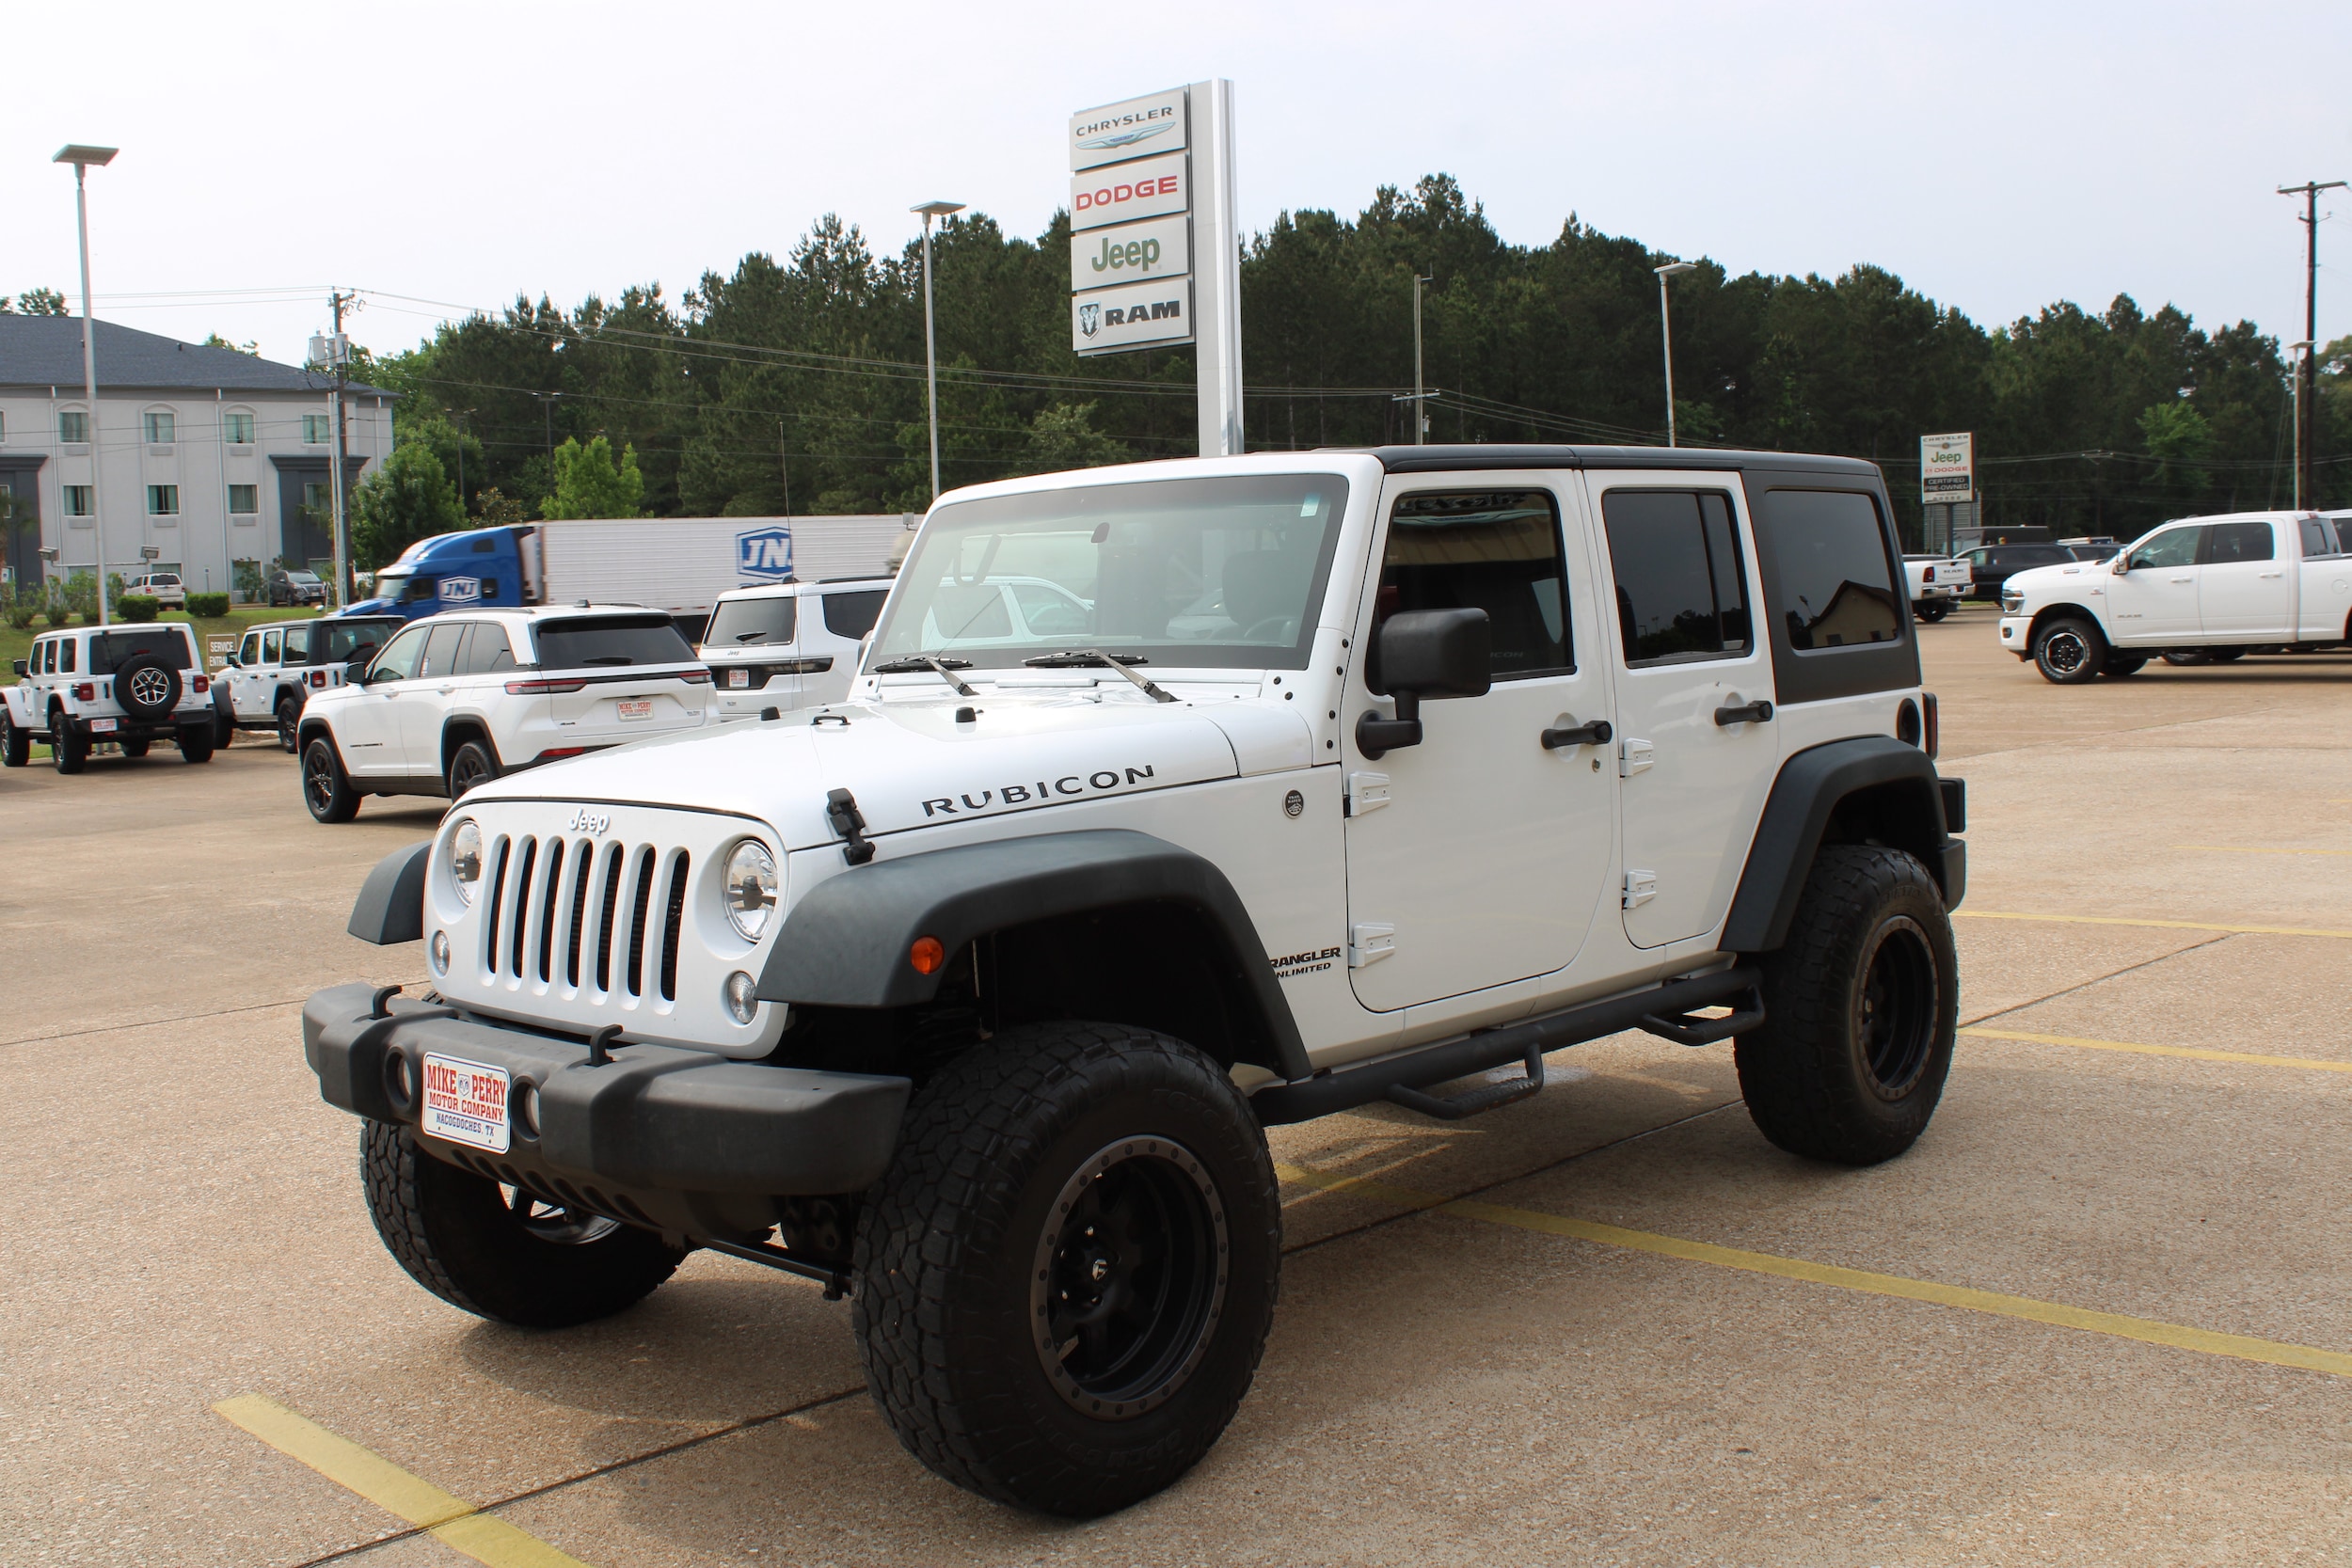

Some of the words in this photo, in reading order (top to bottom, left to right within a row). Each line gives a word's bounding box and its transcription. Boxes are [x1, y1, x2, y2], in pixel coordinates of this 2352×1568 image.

[1076, 106, 1173, 136] CHRYSLER
[1075, 175, 1178, 211] DODGE
[1091, 237, 1160, 272] Jeep
[1105, 300, 1180, 326] RAM
[1931, 451, 1962, 465] Jeep
[1924, 483, 1969, 492] PRE-OWNED
[1928, 477, 1965, 485] CERTIFIED
[210, 641, 234, 653] SERVICE
[209, 656, 228, 667] ENTRA
[921, 765, 1154, 816] RUBICON
[568, 808, 611, 837] Jeep
[1268, 946, 1342, 969] RANGLER
[1276, 962, 1331, 979] NLIMITED
[427, 1064, 457, 1096] MIKE
[471, 1074, 506, 1106] PERRY
[429, 1092, 458, 1111] MOTOR
[461, 1100, 504, 1121] COMPANY
[485, 1125, 495, 1137] TX
